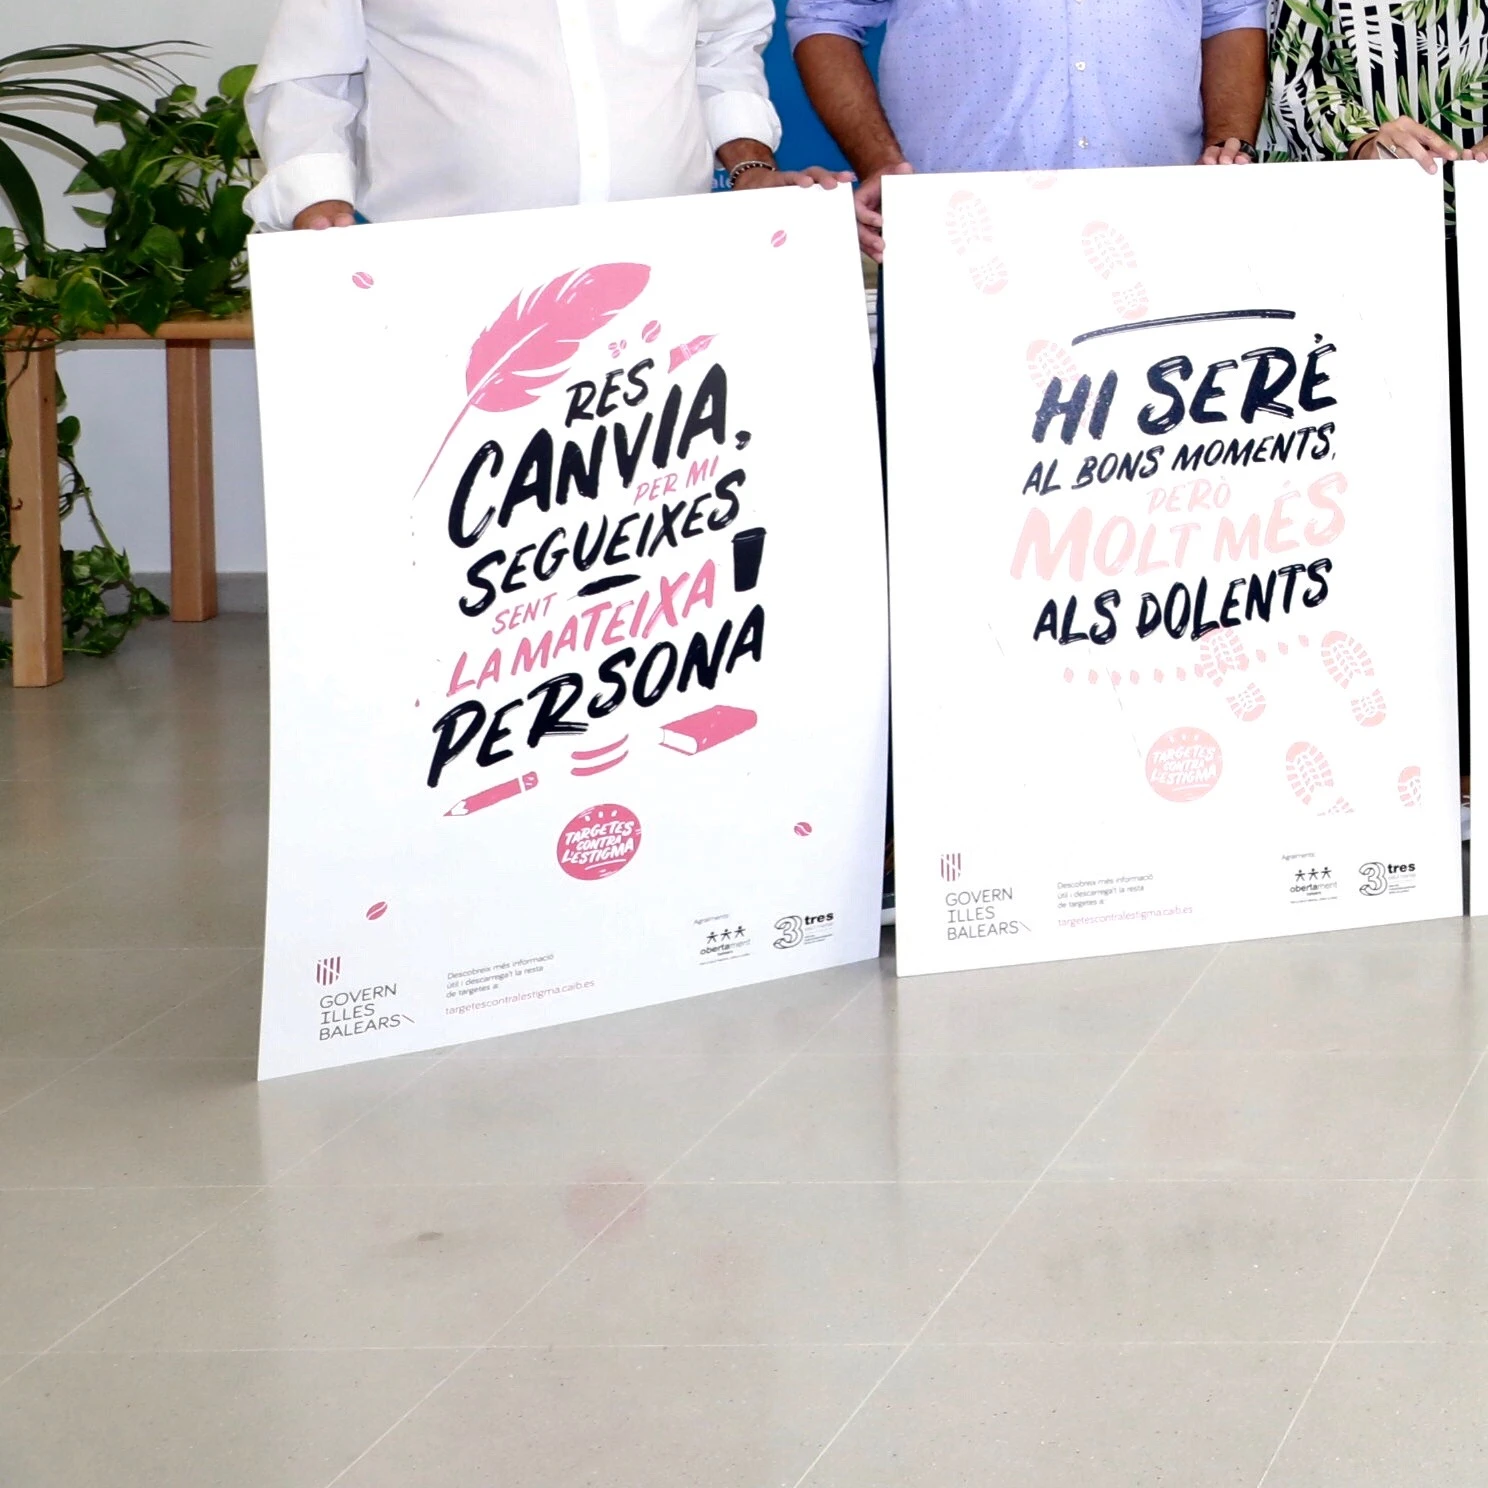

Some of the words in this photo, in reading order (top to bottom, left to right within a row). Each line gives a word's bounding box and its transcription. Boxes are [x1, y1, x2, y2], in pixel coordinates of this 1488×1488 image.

[565, 358, 654, 427] RES
[1031, 370, 1118, 445] HI
[448, 363, 752, 548] CANVIA,
[1022, 459, 1061, 496] AL
[1072, 445, 1164, 490] BONS
[633, 475, 677, 505] PER
[686, 456, 720, 488] MI
[458, 469, 748, 617] SEGUEIXES
[1010, 506, 1202, 582] MOLT
[1213, 471, 1348, 562] MÉS
[491, 594, 558, 635] SENT
[1033, 589, 1121, 645] ALS
[1136, 558, 1333, 642] DOLENTS
[446, 651, 499, 696] LA
[511, 559, 717, 684] MATEIXA
[427, 604, 765, 787] PERSONA
[561, 838, 634, 864] L'ESTIGMA
[565, 820, 634, 845] TARGETES
[576, 835, 621, 850] CONTRA
[1388, 863, 1415, 873] tres
[805, 913, 834, 925] tres
[946, 887, 1012, 906] GOVERN
[947, 906, 995, 923] ILLES
[320, 983, 396, 1008] GOVERN
[321, 1003, 375, 1025] ILLES
